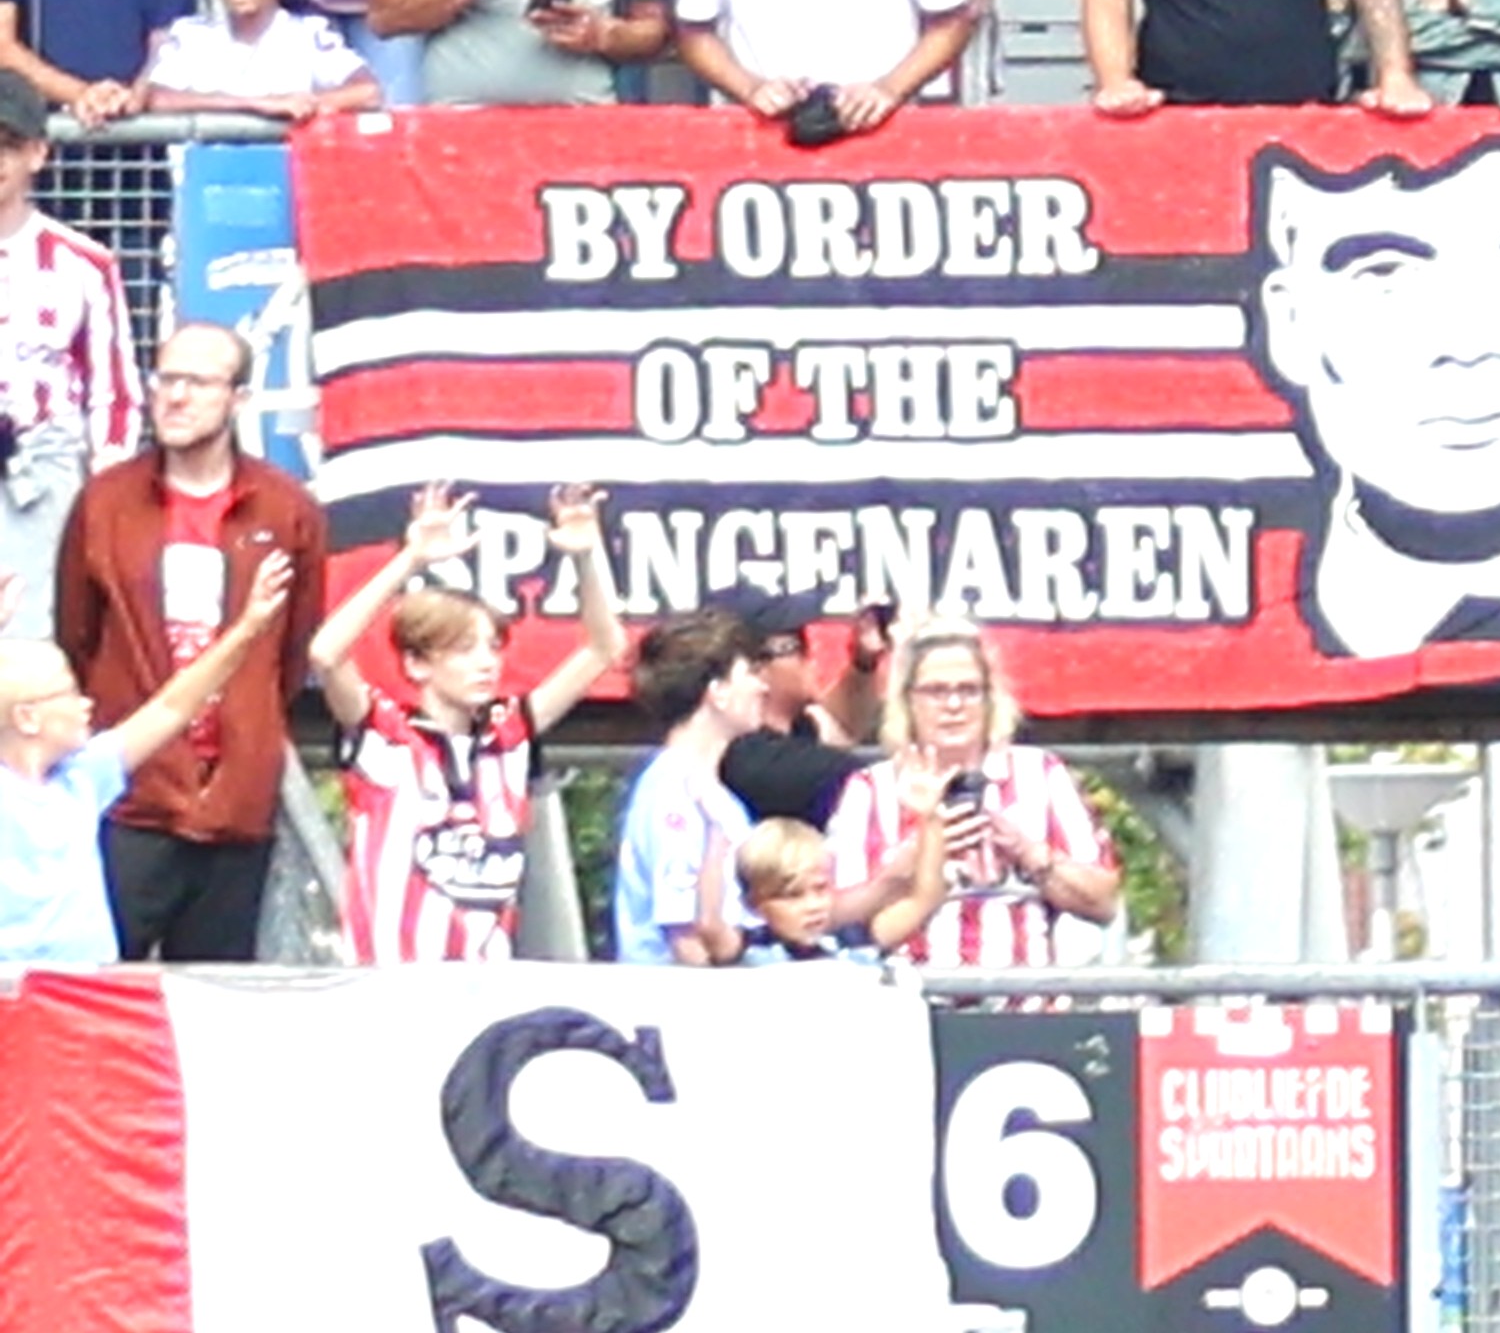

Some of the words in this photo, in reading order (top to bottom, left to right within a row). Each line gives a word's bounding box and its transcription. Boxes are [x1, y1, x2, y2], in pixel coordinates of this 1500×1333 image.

[542, 186, 685, 280] BY
[718, 178, 1099, 278] ORDER
[636, 345, 771, 443] OF
[796, 342, 1016, 441] THE
[421, 1007, 699, 1333] S
[944, 1060, 1098, 1269] 6
